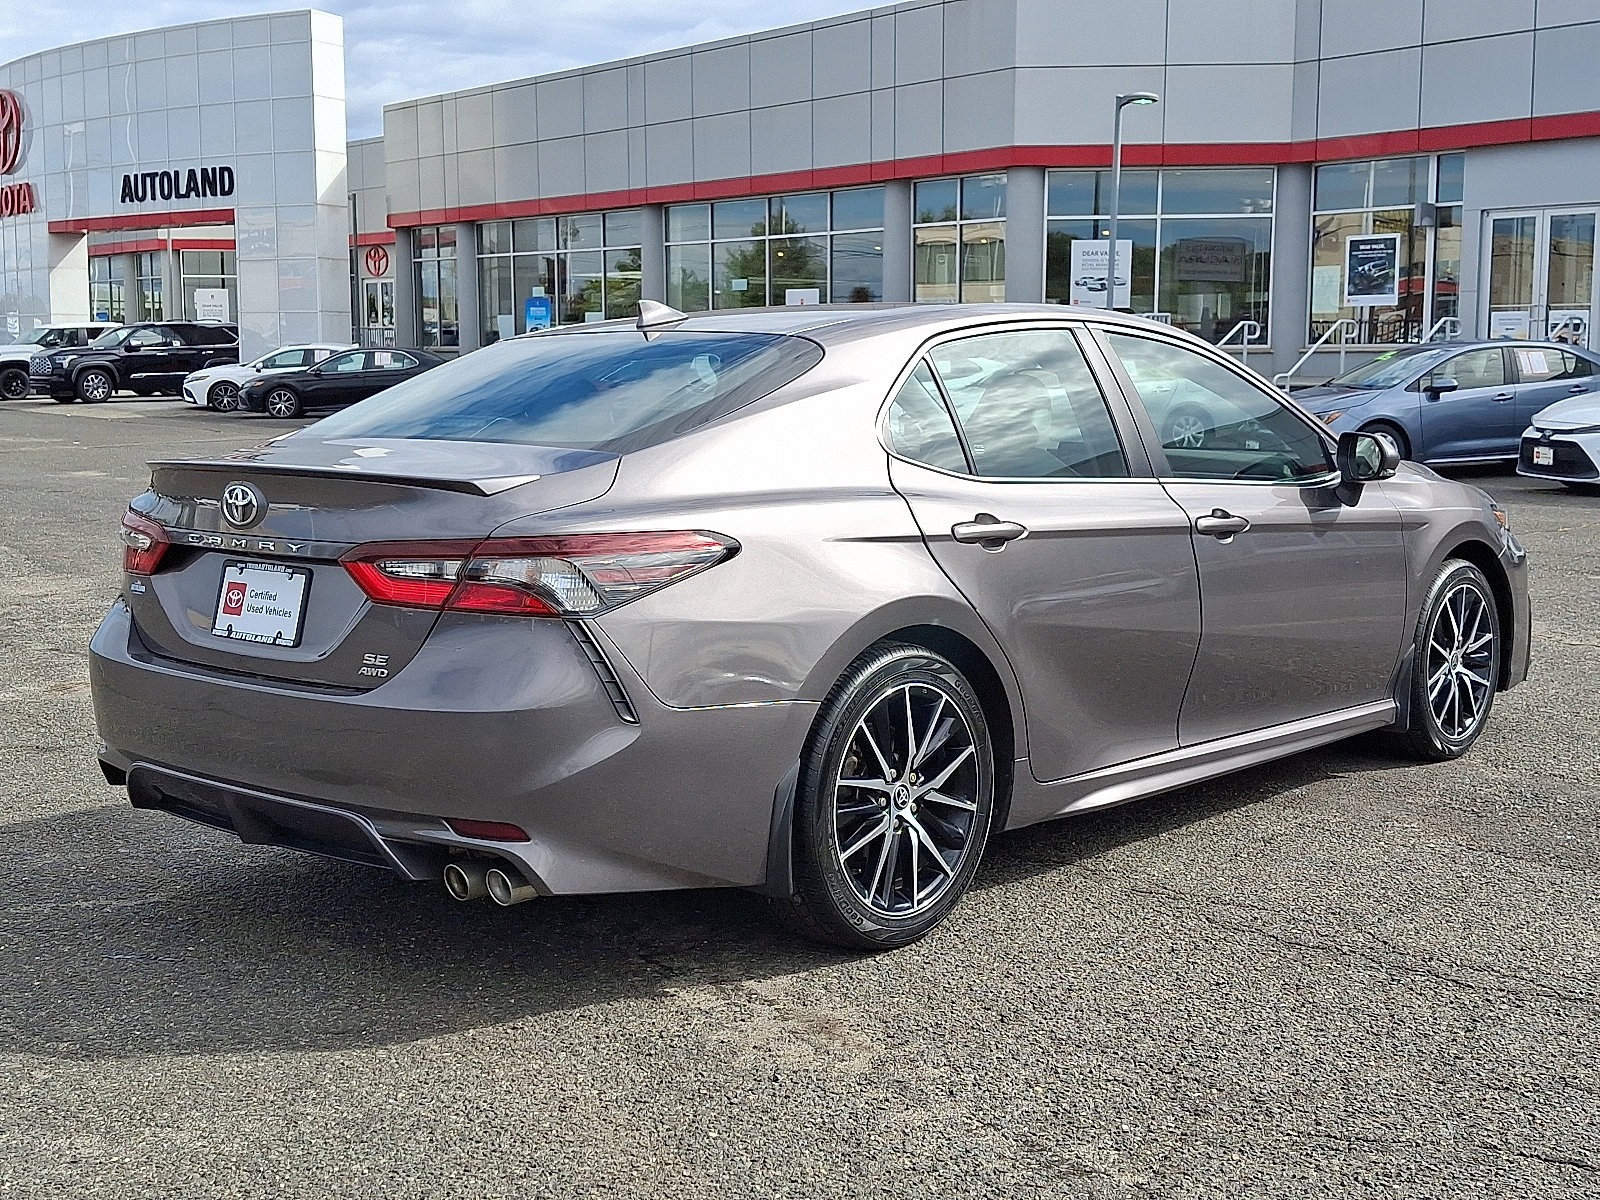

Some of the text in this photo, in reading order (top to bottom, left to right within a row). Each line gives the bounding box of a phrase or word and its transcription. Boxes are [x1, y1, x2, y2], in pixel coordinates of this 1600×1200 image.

[120, 166, 235, 203] AUTOLAND
[0, 183, 34, 217] OTA
[188, 533, 307, 553] CAMRY
[249, 589, 278, 602] Certified
[246, 603, 293, 619] Used Vehicles
[230, 631, 274, 644] AUTOLAND
[362, 653, 390, 666] SE
[358, 666, 389, 678] AWD
